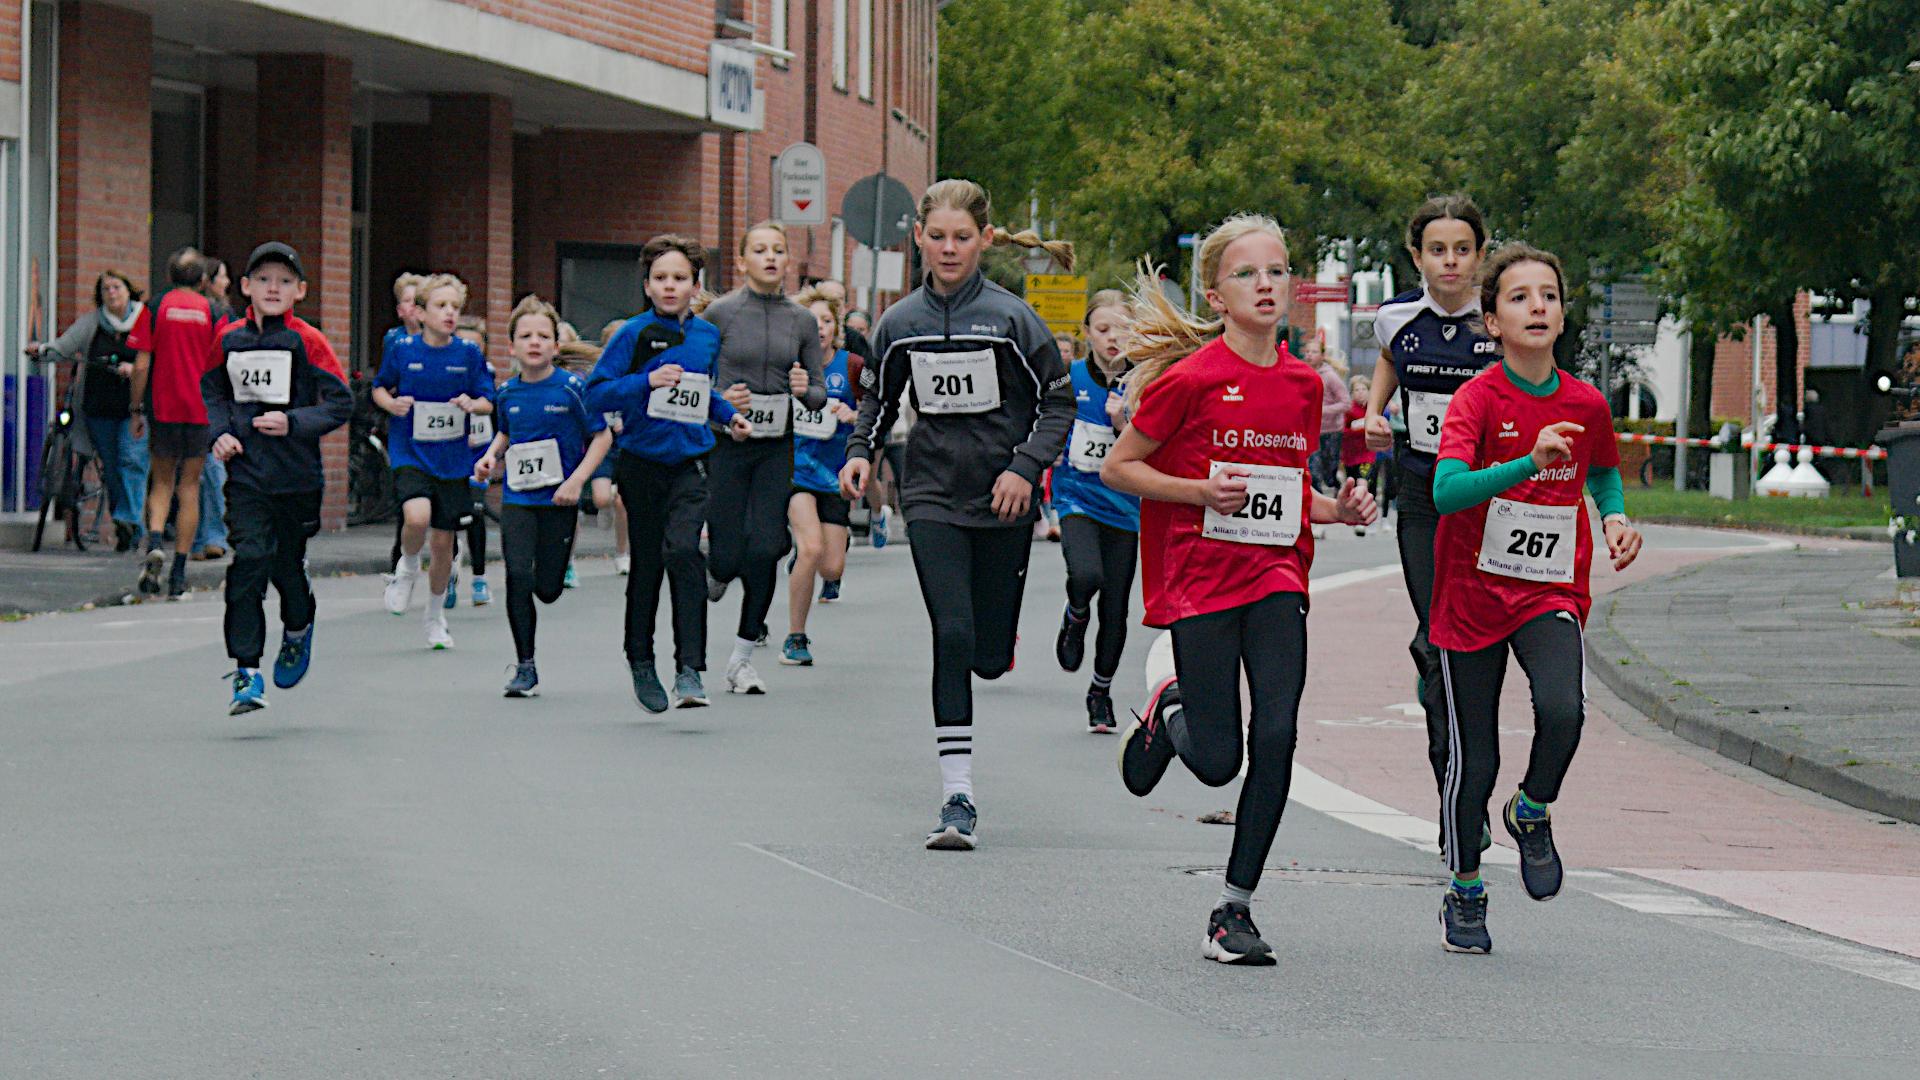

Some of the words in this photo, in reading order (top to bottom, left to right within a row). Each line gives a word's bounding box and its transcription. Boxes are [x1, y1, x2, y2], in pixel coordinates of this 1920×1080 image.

[719, 61, 752, 113] ACTION
[1473, 341, 1496, 354] 09
[240, 368, 272, 387] 244
[1406, 364, 1438, 375] FIRST
[931, 373, 974, 396] 201
[666, 387, 700, 408] 250
[426, 413, 455, 429] 254
[744, 407, 774, 424] 284
[795, 408, 823, 425] 239
[1426, 414, 1443, 436] 3
[1212, 428, 1239, 449] LG
[1083, 440, 1114, 459] 23
[517, 457, 544, 475] 257
[1231, 492, 1284, 521] 264
[1212, 525, 1238, 536] Allianz
[1251, 528, 1270, 538] Claus
[1272, 530, 1295, 539] Terbeck
[1506, 528, 1560, 559] 267
[1487, 557, 1512, 570] Allianz
[1525, 565, 1544, 575] Claus
